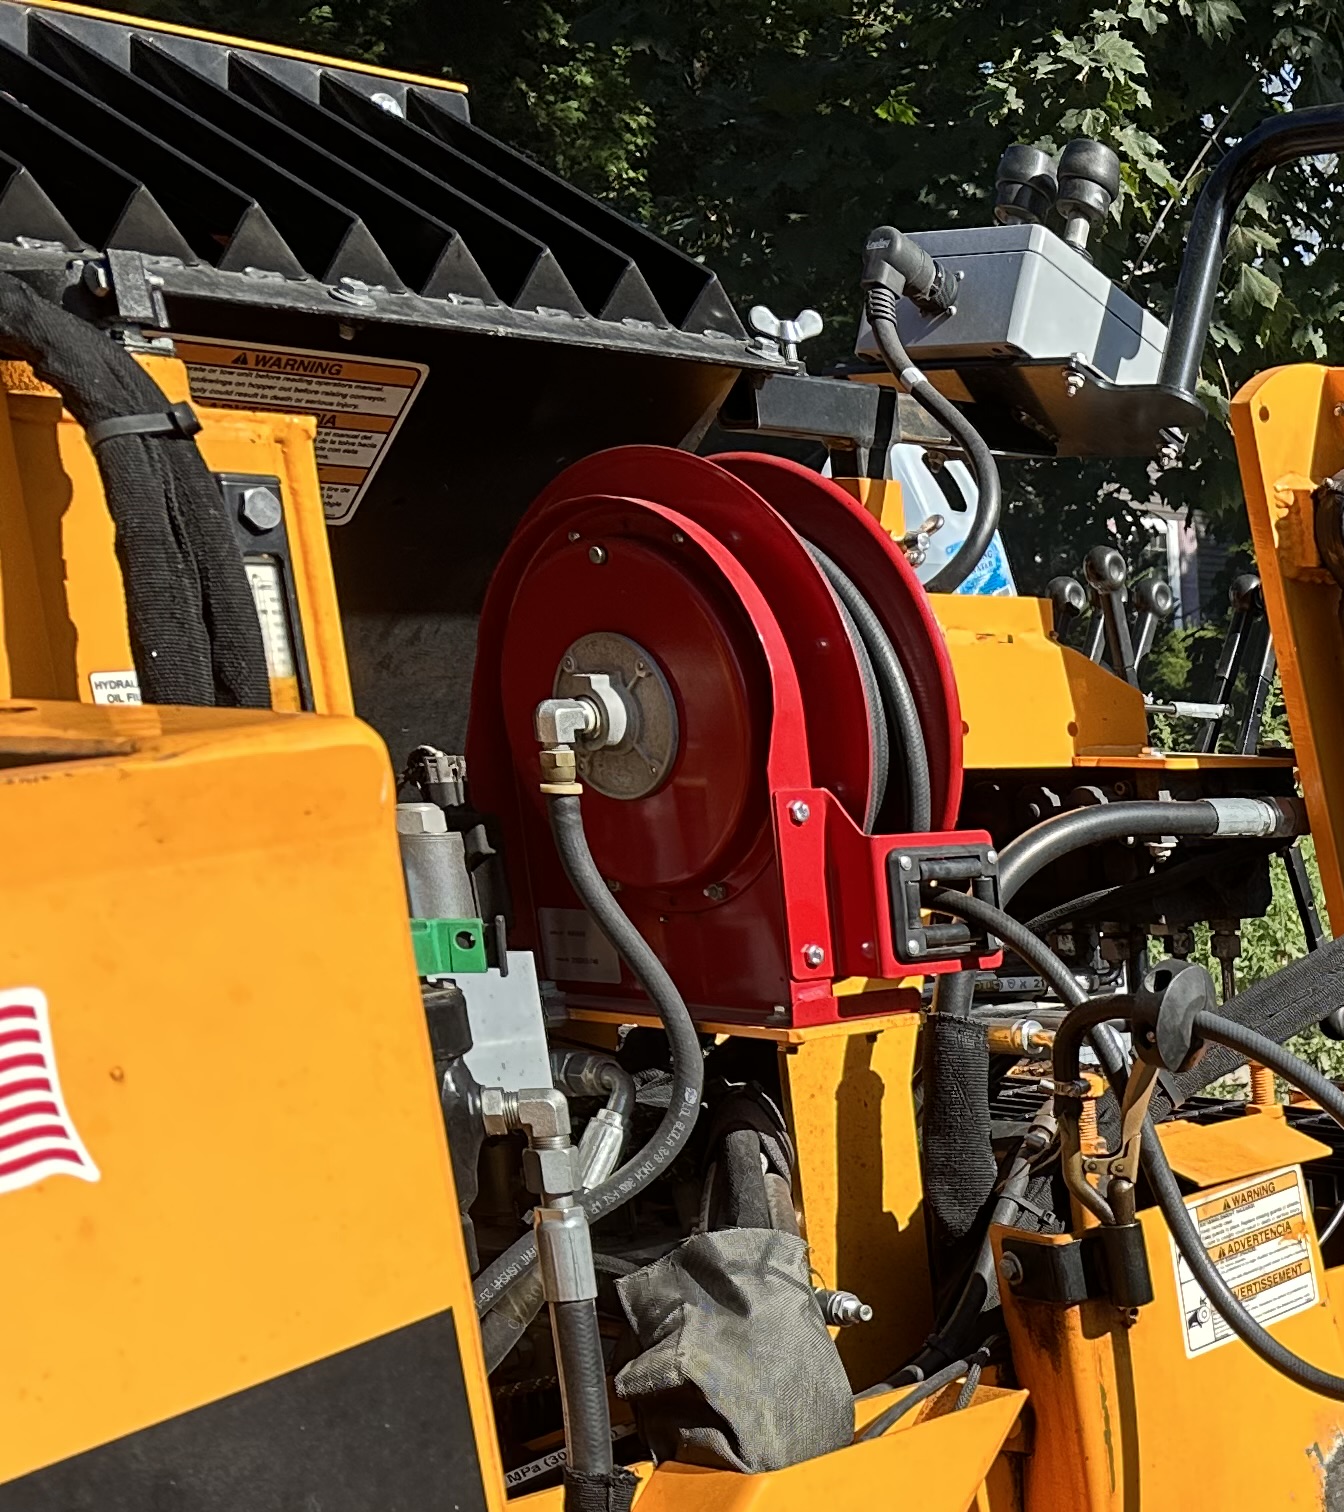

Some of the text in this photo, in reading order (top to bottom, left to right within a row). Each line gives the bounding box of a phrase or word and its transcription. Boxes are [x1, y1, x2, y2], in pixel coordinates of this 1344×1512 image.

[255, 354, 343, 376] WARNING
[255, 372, 281, 380] before
[282, 376, 313, 385] reading
[293, 386, 320, 395] before
[107, 693, 125, 704] OIL
[634, 1160, 656, 1182] INCH
[1231, 1181, 1276, 1207] WARNING
[1227, 1220, 1292, 1255] ADVERTENCIA
[1234, 1262, 1303, 1299] VERTISSEMENT
[506, 1462, 542, 1484] MPa
